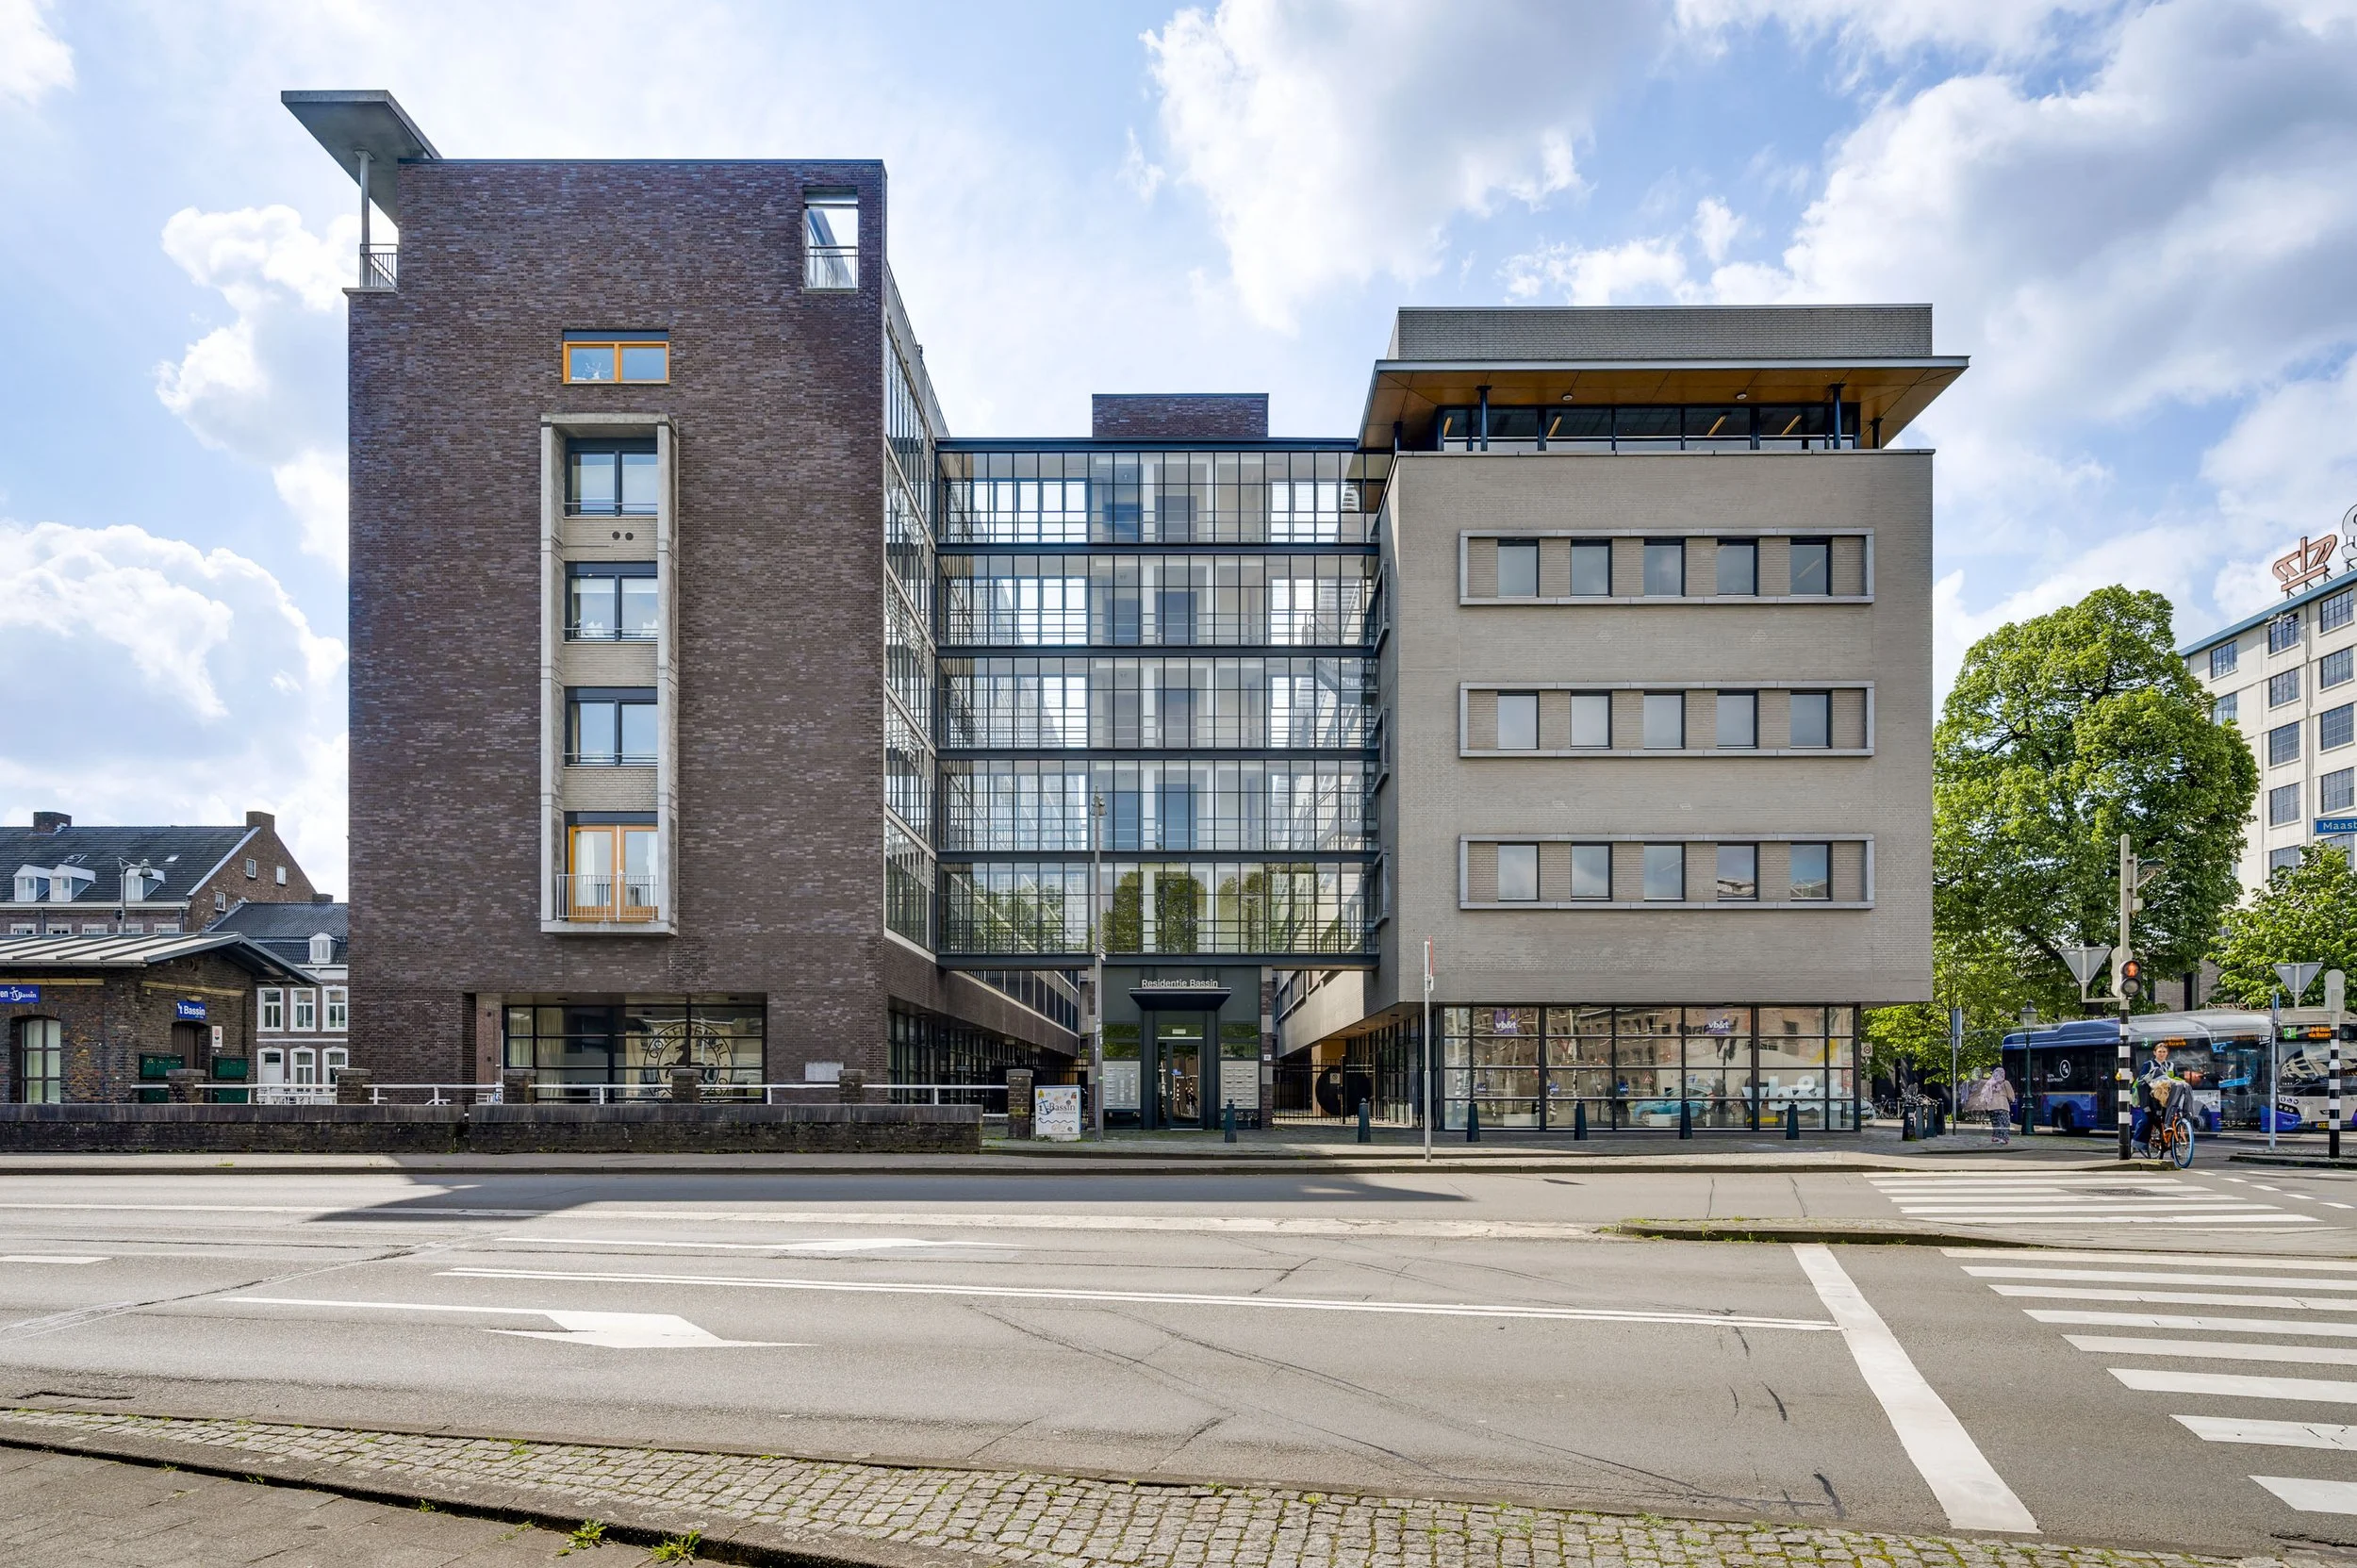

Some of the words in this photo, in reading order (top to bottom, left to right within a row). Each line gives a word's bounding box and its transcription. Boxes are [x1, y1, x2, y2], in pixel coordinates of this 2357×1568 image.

[1142, 979, 1187, 987] Residentie
[1190, 979, 1218, 988] Bassin
[176, 1002, 183, 1015] 't
[183, 1005, 206, 1016] Bassin
[2286, 1028, 2292, 1038] 3
[1741, 1075, 1842, 1111] vb&t
[1049, 1102, 1076, 1112] Bassin
